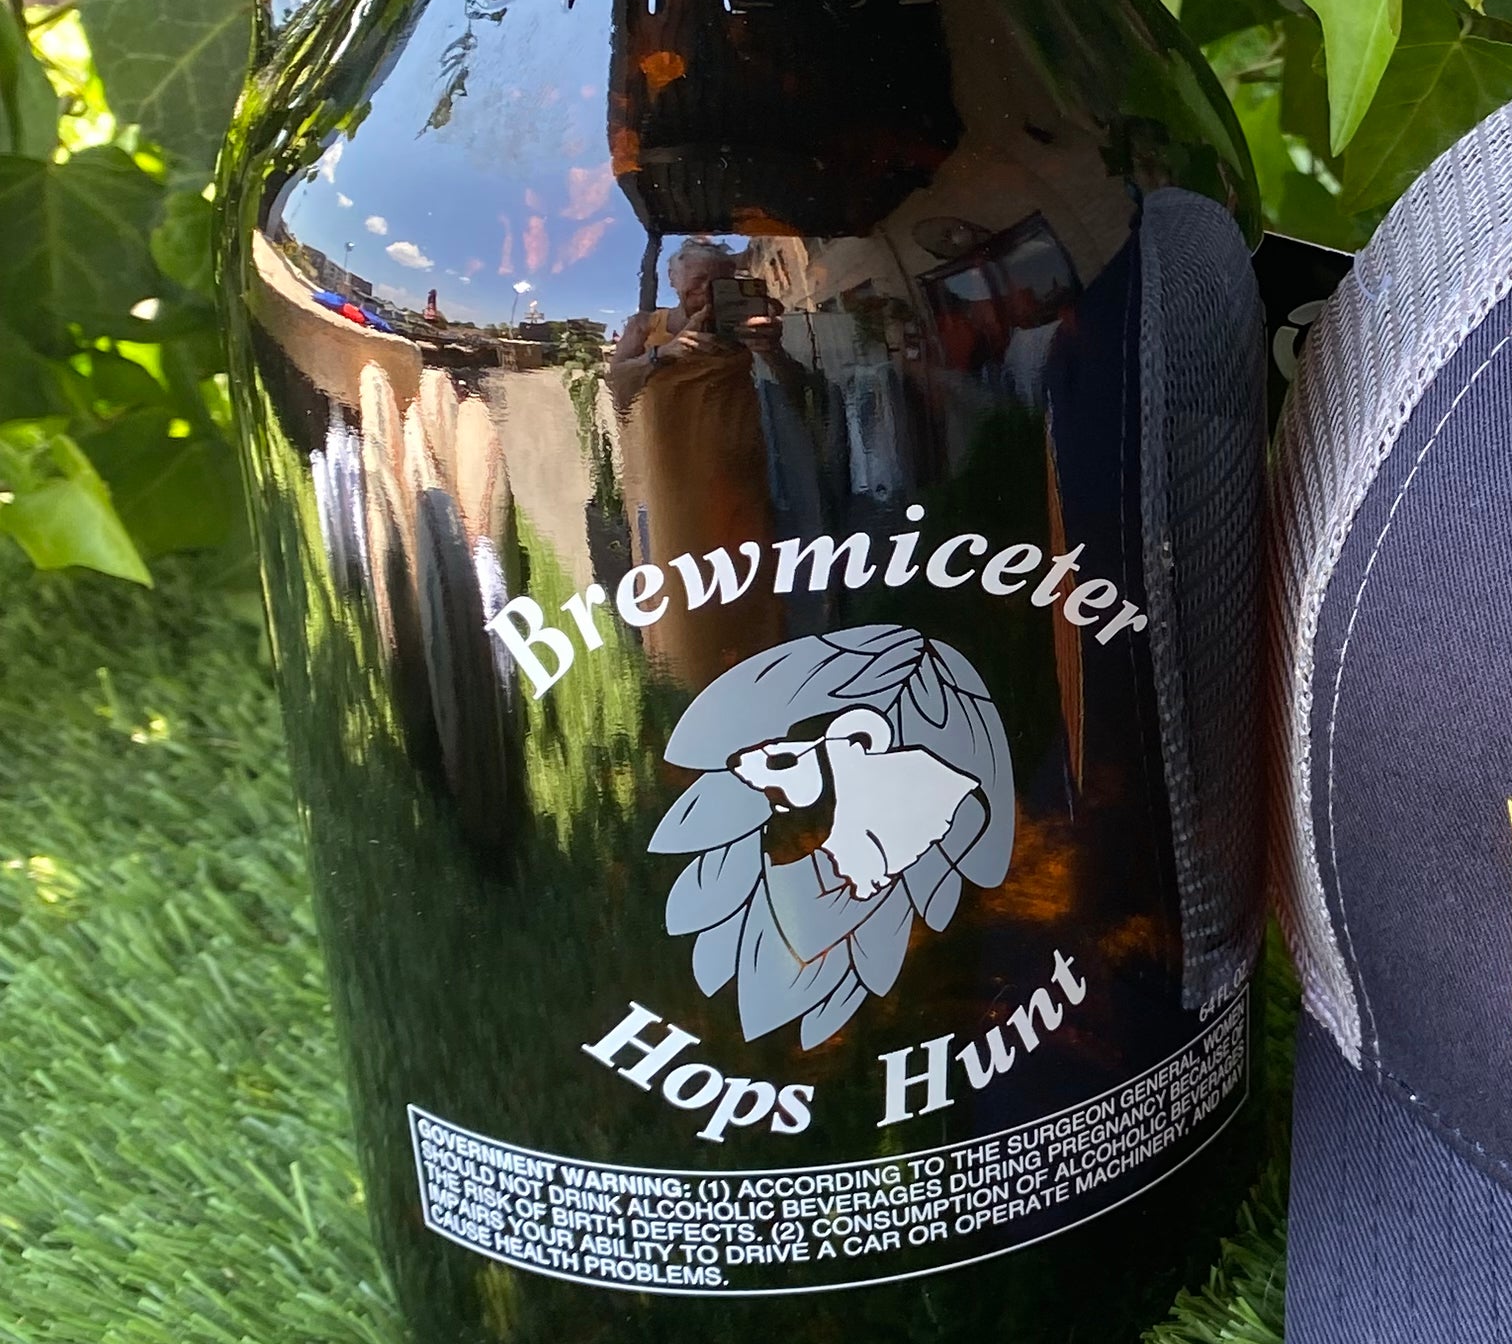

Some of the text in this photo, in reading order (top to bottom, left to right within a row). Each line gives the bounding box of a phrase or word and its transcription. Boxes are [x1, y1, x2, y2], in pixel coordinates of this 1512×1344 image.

[484, 504, 1149, 699] Brewmiceter
[418, 998, 1245, 1202] GOVERNMENT WARNING: (1) ACCORDING TO THE SURGEON GENERAL, WOMEN
[421, 1017, 1245, 1220] SHOULD NOT DRINK ALCOHOLIC BEVERAGES DURING PREGNANCY BECAUSE OF
[424, 1039, 1245, 1244] THE RISK OF BIRTH DEFECTS. (2) CONSUMPTION OF ALCOHOLIC BEVERAGES
[581, 949, 1088, 1143] Hops Hunt
[428, 1057, 1245, 1265] IMPAIRS YOUR ABILITY TO DRIVE A CAR OR OPERATE MACHINERY, AND MAY
[430, 1205, 729, 1287] CAUSE HEALTH PROBLEMS.
